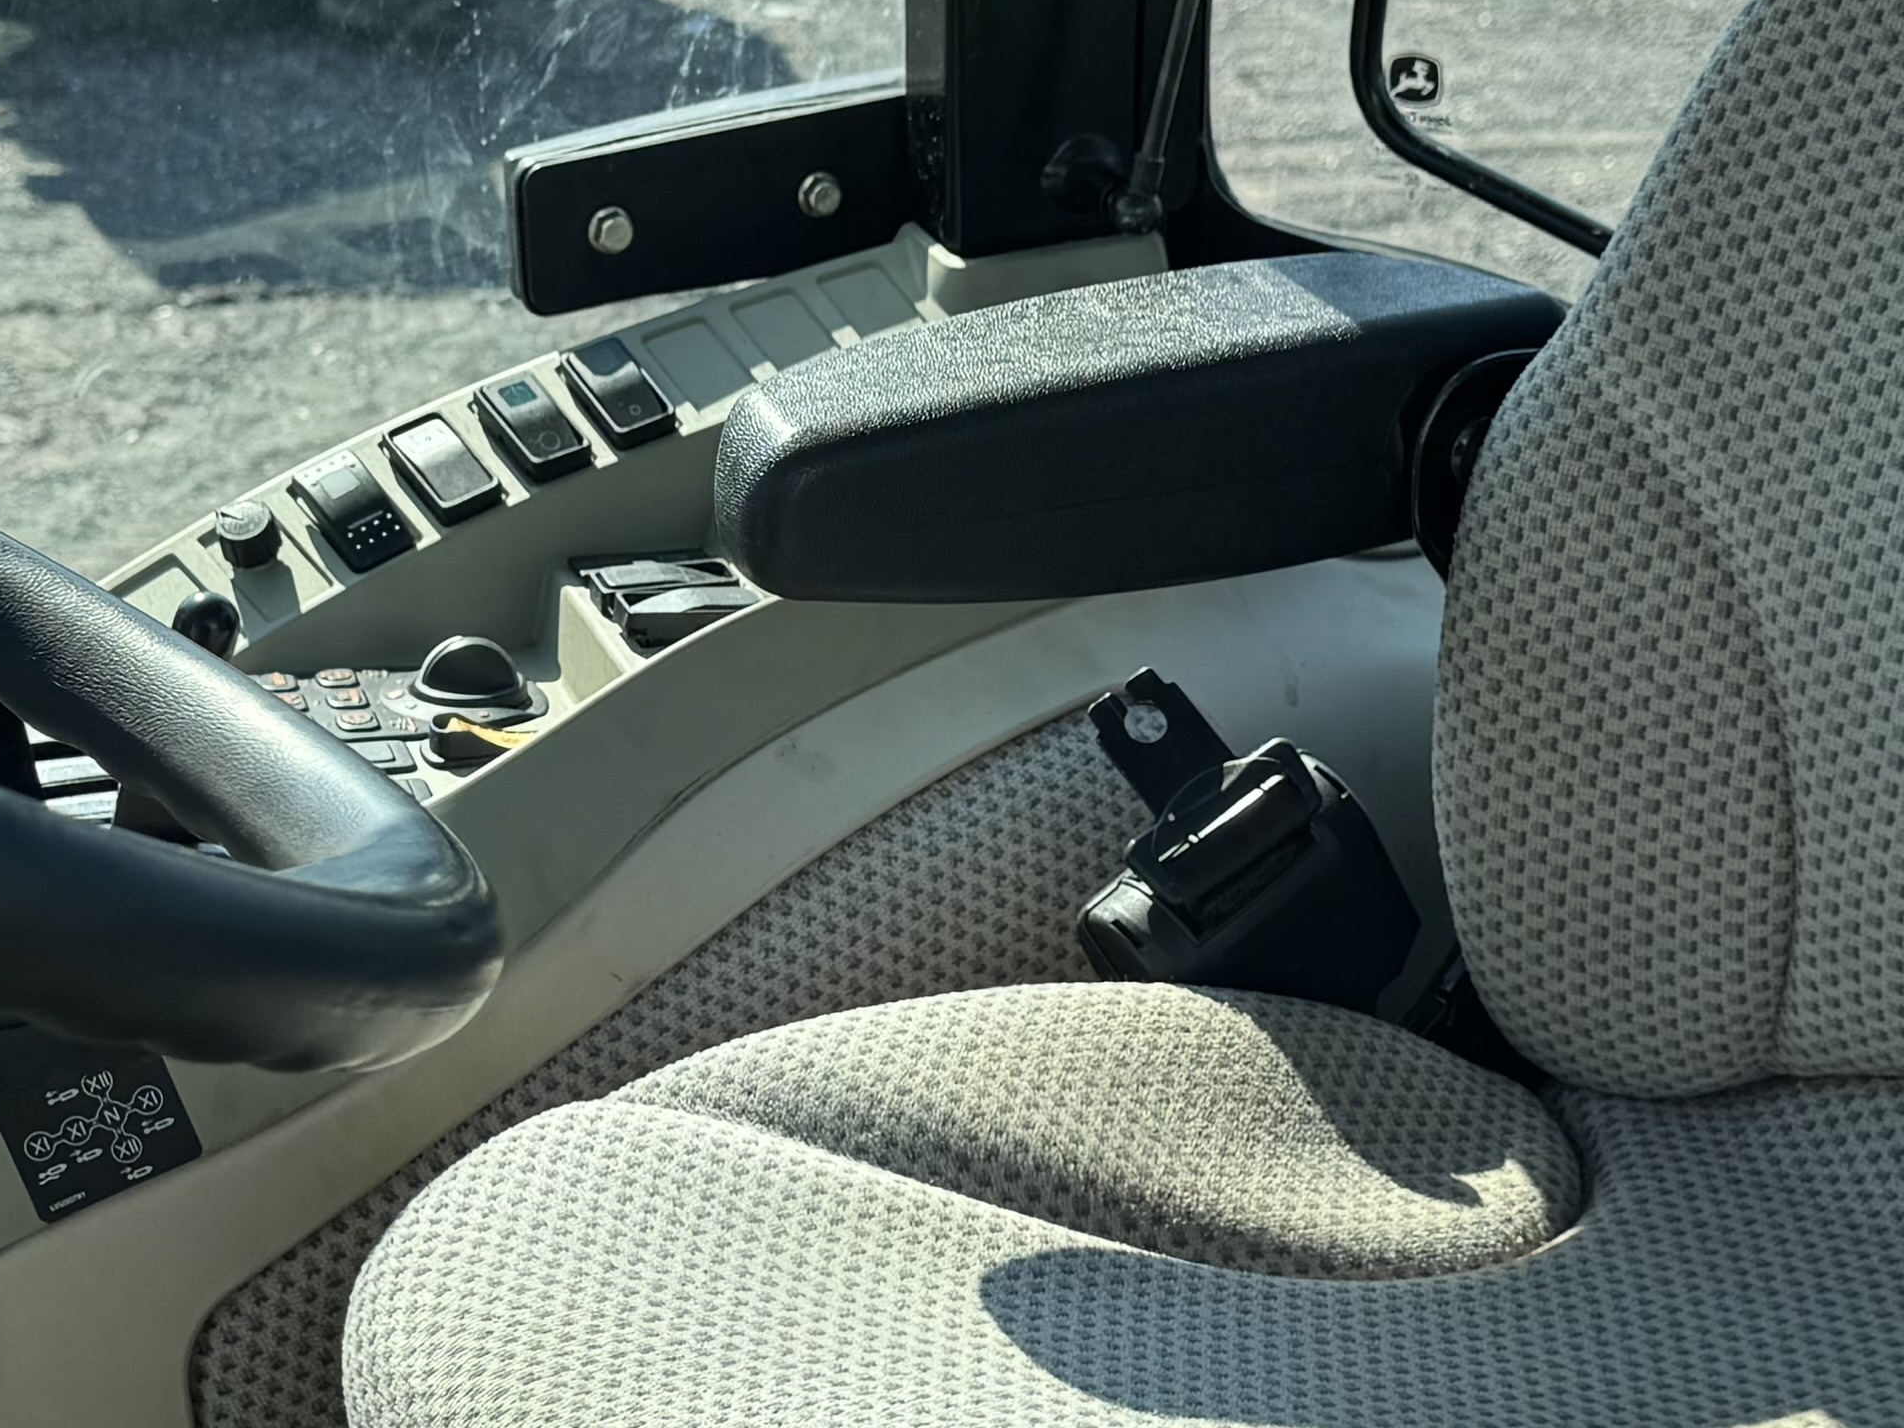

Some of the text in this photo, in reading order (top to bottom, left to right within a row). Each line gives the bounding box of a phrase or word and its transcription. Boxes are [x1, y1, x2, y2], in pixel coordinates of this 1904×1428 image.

[86, 1071, 112, 1093] XII
[138, 1090, 160, 1109] XI
[104, 1107, 121, 1124] N
[65, 1121, 87, 1140] XI
[29, 1137, 52, 1156] XI
[115, 1138, 139, 1159] XII
